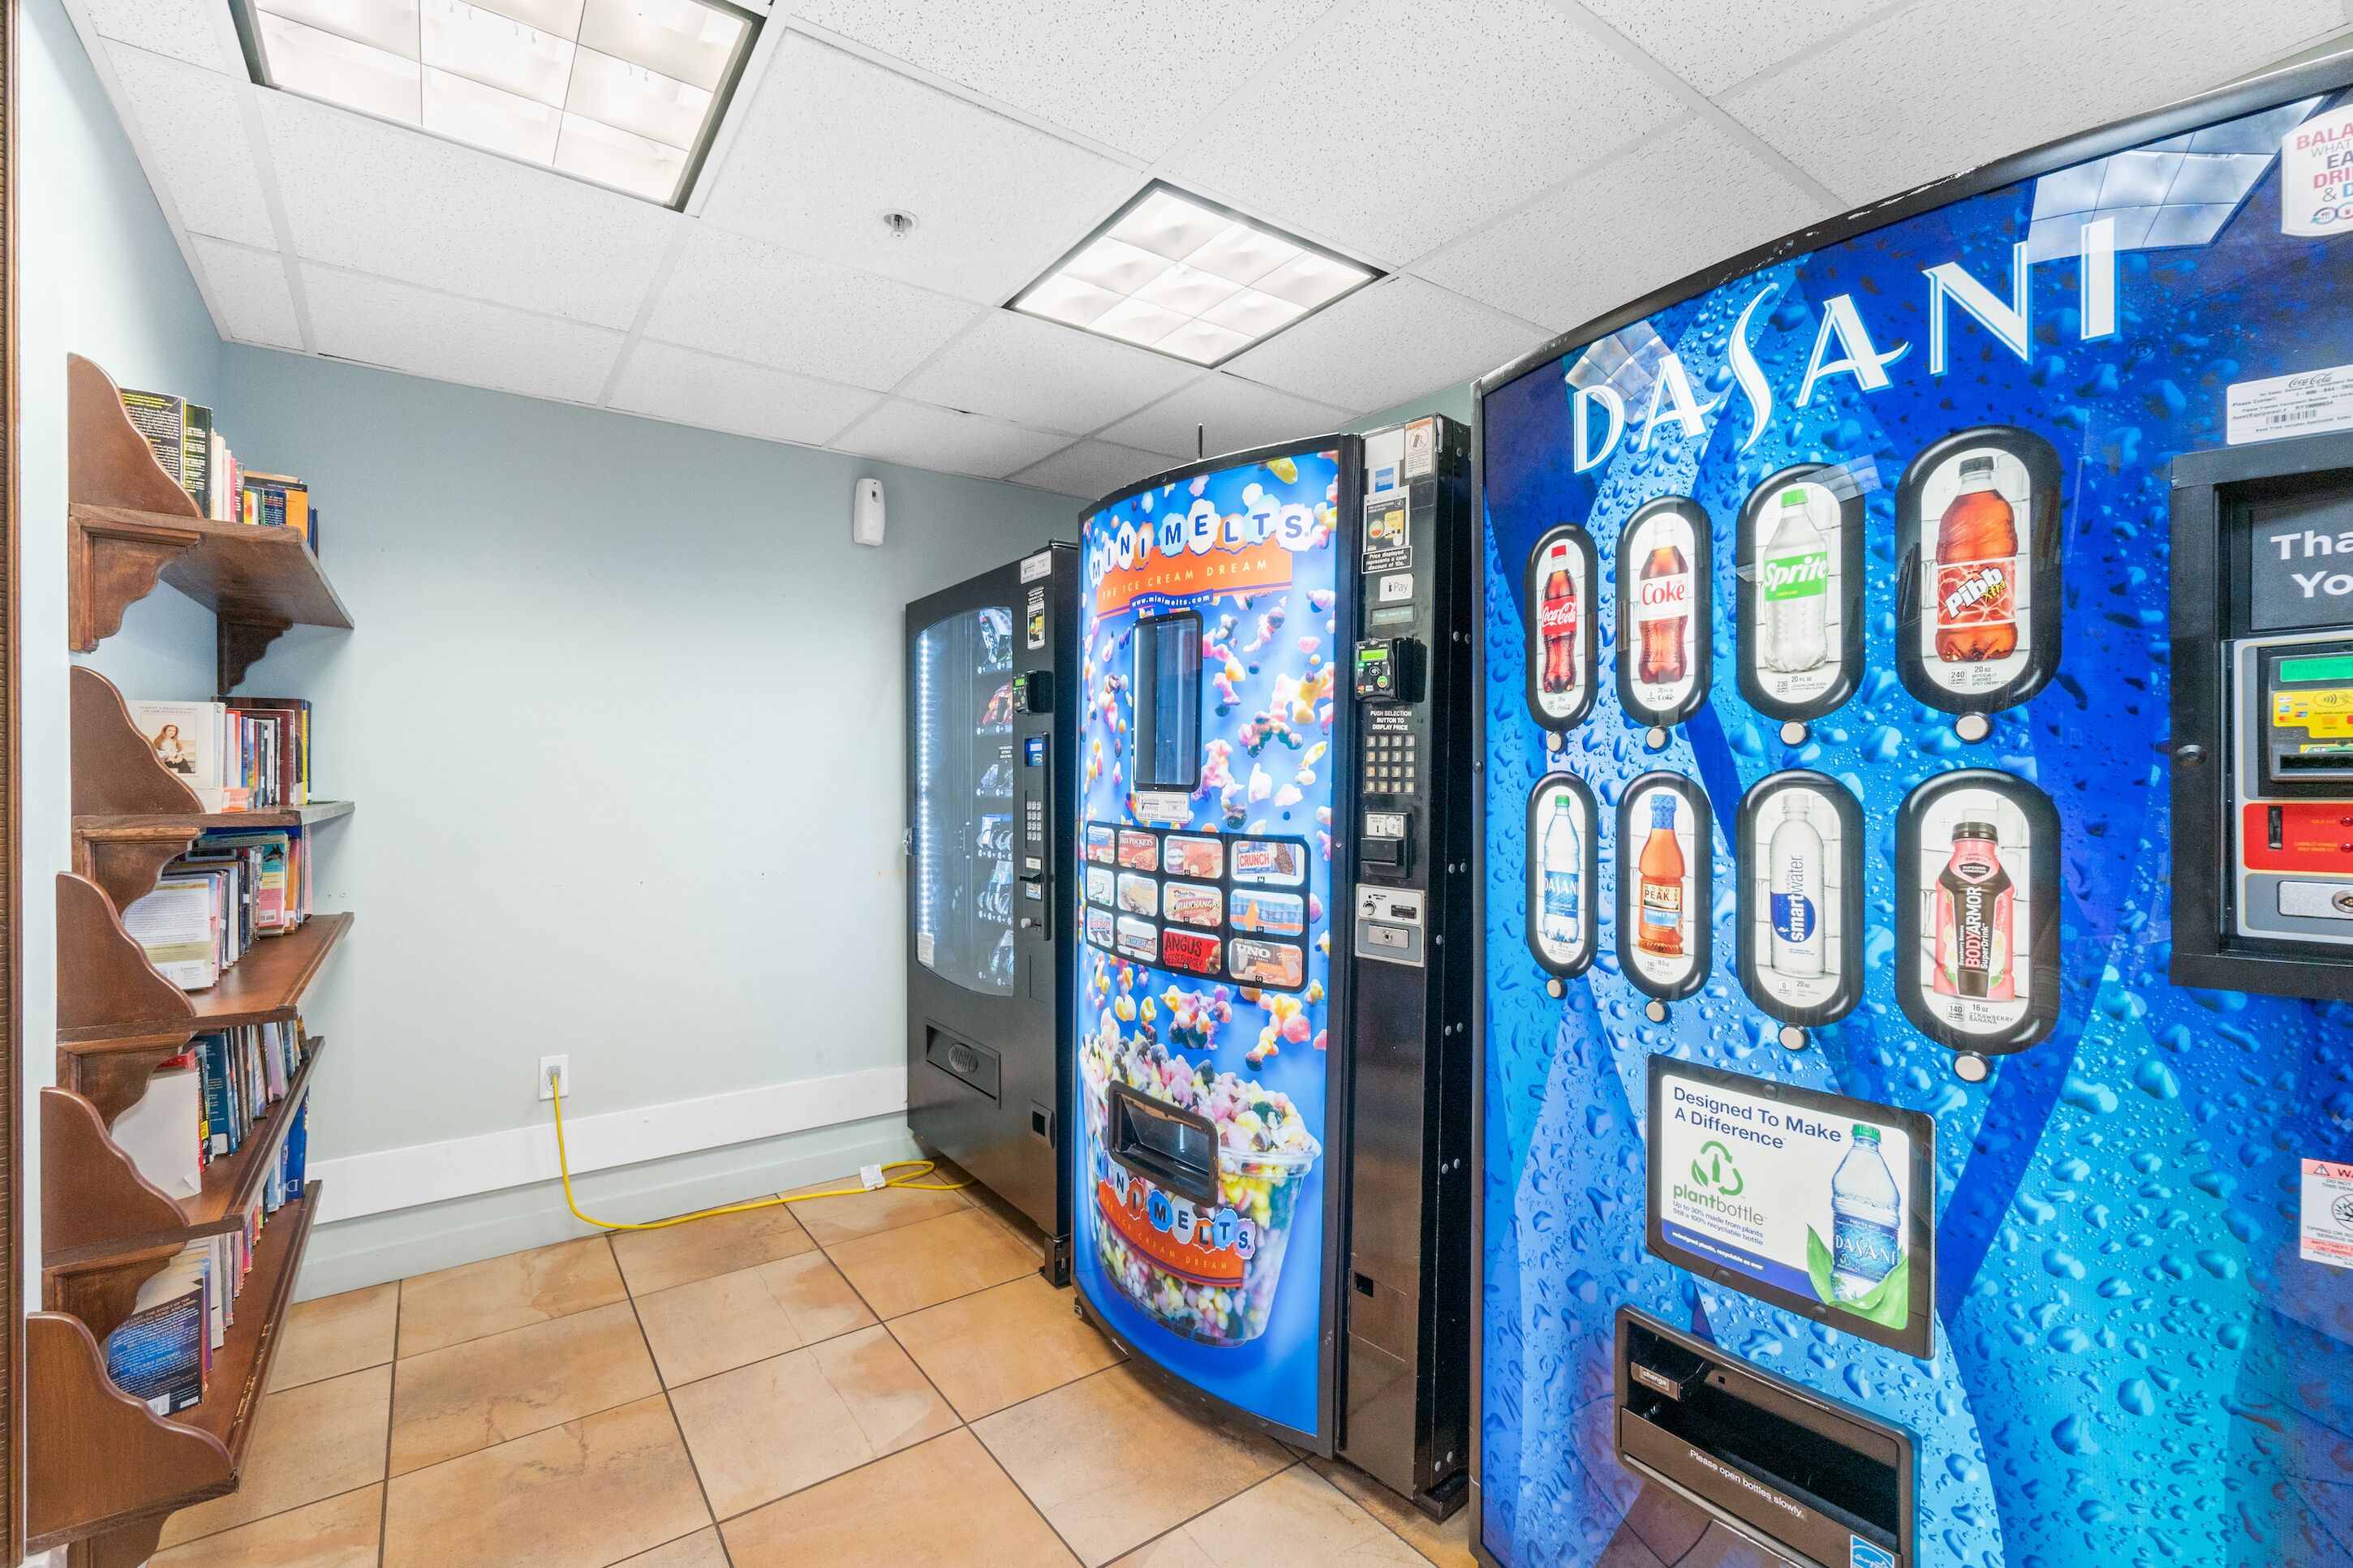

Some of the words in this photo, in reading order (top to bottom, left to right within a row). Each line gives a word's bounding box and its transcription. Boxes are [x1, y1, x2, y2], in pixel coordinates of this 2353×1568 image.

[2312, 140, 2351, 157] WHAT
[1573, 216, 2116, 475] DASANI
[1092, 538, 1146, 579] MINI
[1165, 513, 1304, 547] MELTS
[1103, 587, 1117, 599] THE
[1123, 581, 1139, 593] ICE
[1147, 569, 1194, 587] CREAM
[1207, 559, 1267, 577] DREAM
[1764, 555, 1828, 592] Sprite
[1132, 595, 1210, 607] www.minimelts.com
[1394, 582, 1409, 594] Pay
[1642, 581, 1684, 605] Coke
[1944, 567, 2004, 620] Pibb
[1542, 601, 1577, 627] Coca-Cola
[1129, 837, 1153, 846] POCKETS
[1240, 853, 1270, 867] CRUNCH
[1172, 900, 1220, 912] CHIMICHANGAS
[1645, 889, 1670, 901] PEAK
[1965, 886, 1981, 969] BODYARMOR
[1165, 934, 1202, 957] ANGUS
[1969, 1012, 2013, 1022] STRAWBERRY
[951, 1046, 973, 1072] PUSH
[1674, 1087, 1753, 1121] Designed
[1758, 1108, 1779, 1127] To
[1786, 1115, 1842, 1143] Make
[1675, 1107, 1686, 1122] A
[1691, 1111, 1783, 1149] Difference
[1097, 1155, 1136, 1209] MINI
[1154, 1202, 1248, 1249] MELTS
[1674, 1184, 1763, 1225] plantbottle
[1102, 1192, 1114, 1212] THE
[1118, 1215, 1131, 1231] ICE
[1138, 1233, 1175, 1257] CREAM
[1185, 1257, 1227, 1269] DREAM
[1673, 1208, 1684, 1216] Still
[1691, 1214, 1706, 1225] 100%
[1707, 1221, 1740, 1238] recyclable
[1743, 1234, 1763, 1245] bottle
[1691, 1207, 1704, 1216] 30%
[1706, 1214, 1724, 1223] made
[1725, 1219, 1740, 1230] from
[1742, 1226, 1763, 1238] plants
[2306, 1226, 2332, 1235] TIPPING
[1835, 1234, 1895, 1265] DASANI
[2317, 1233, 2346, 1241] SERIOUS
[157, 1304, 174, 1313] STORY
[162, 1325, 184, 1337] UNITED
[130, 1358, 154, 1373] LOVERS
[156, 1351, 181, 1363] DIVIDED
[1643, 1369, 1667, 1385] change
[1690, 1450, 1718, 1471] Please
[1719, 1467, 1740, 1484] open
[1743, 1478, 1772, 1500] bottles
